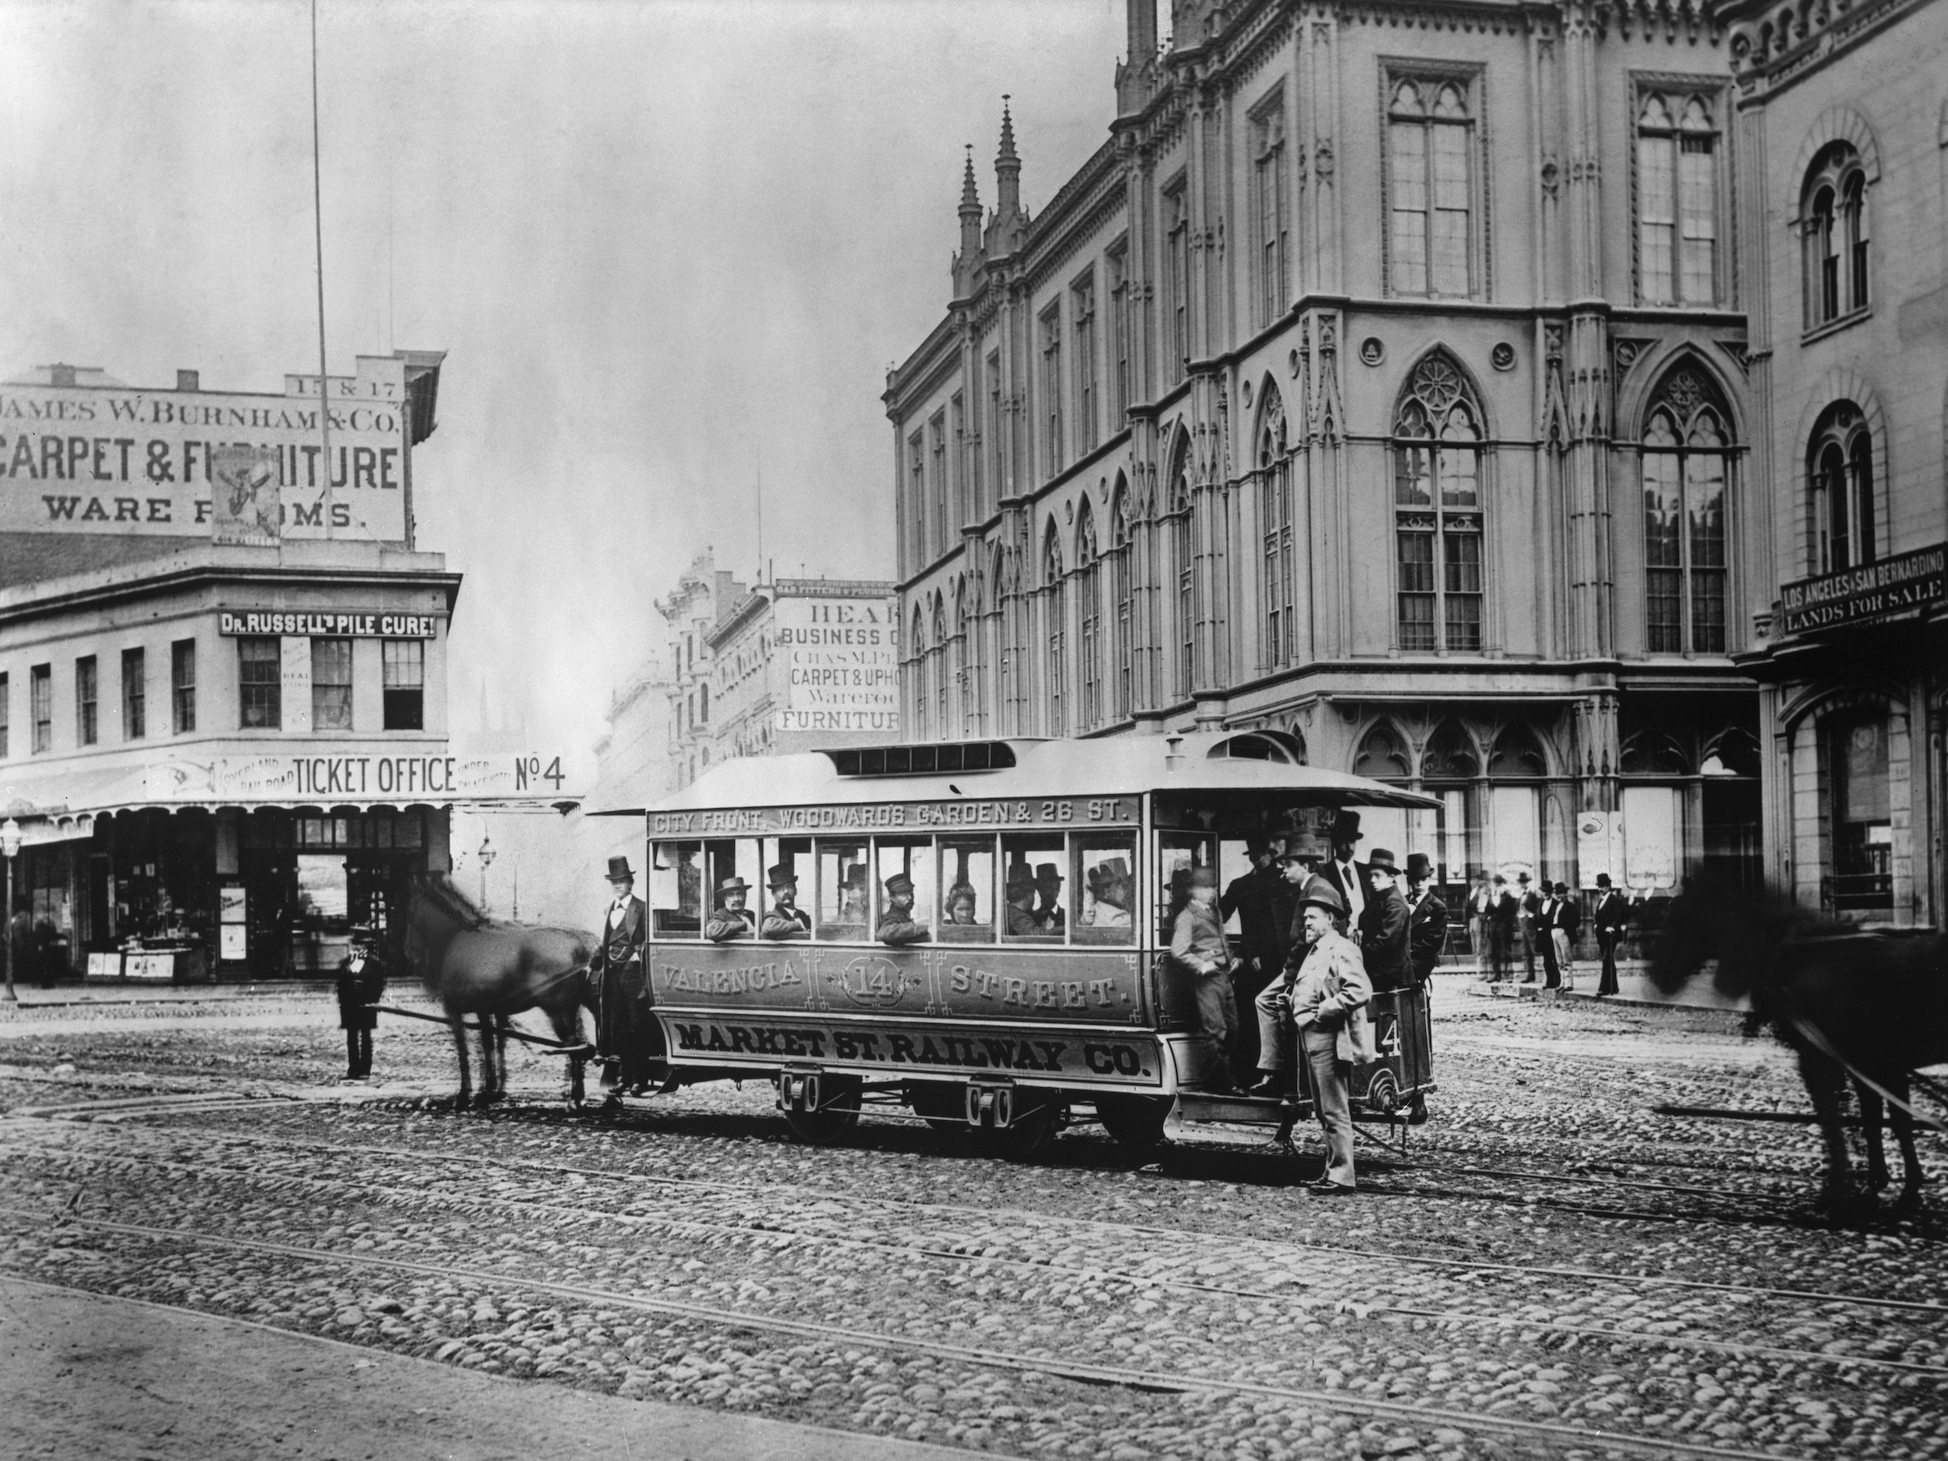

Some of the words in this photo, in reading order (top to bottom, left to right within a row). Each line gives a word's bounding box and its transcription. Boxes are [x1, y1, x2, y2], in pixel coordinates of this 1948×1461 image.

[340, 381, 357, 395] &
[371, 382, 396, 397] 17
[0, 399, 96, 420] AMES
[151, 400, 319, 430] BURNHAM
[146, 438, 175, 482] &
[41, 495, 172, 523] WARE
[1784, 587, 1803, 610] LOS
[1805, 574, 1850, 602] ANGELES
[1855, 567, 1877, 591] SAN
[1787, 603, 1844, 631] LANDS
[1849, 595, 1883, 616] FOR
[1888, 579, 1943, 607] SALE
[337, 614, 376, 635] PILE
[382, 615, 435, 635] CURE!
[781, 628, 880, 645] BUSINESS
[791, 668, 849, 686] CARPET
[293, 758, 370, 794] TICKET
[378, 757, 457, 792] OFFICE
[543, 756, 566, 791] 4
[654, 812, 696, 833] CITY
[916, 802, 1010, 824] GARDEN
[1014, 801, 1032, 822] &
[1041, 800, 1074, 822] 26
[1087, 799, 1130, 821] ST.
[660, 958, 802, 995] VALENCIA
[853, 965, 896, 998] 14
[950, 964, 1131, 1009] STREET.
[674, 1023, 827, 1058] MARKET
[885, 1033, 1068, 1072] RAILWAY
[1083, 1042, 1152, 1077] CO.
